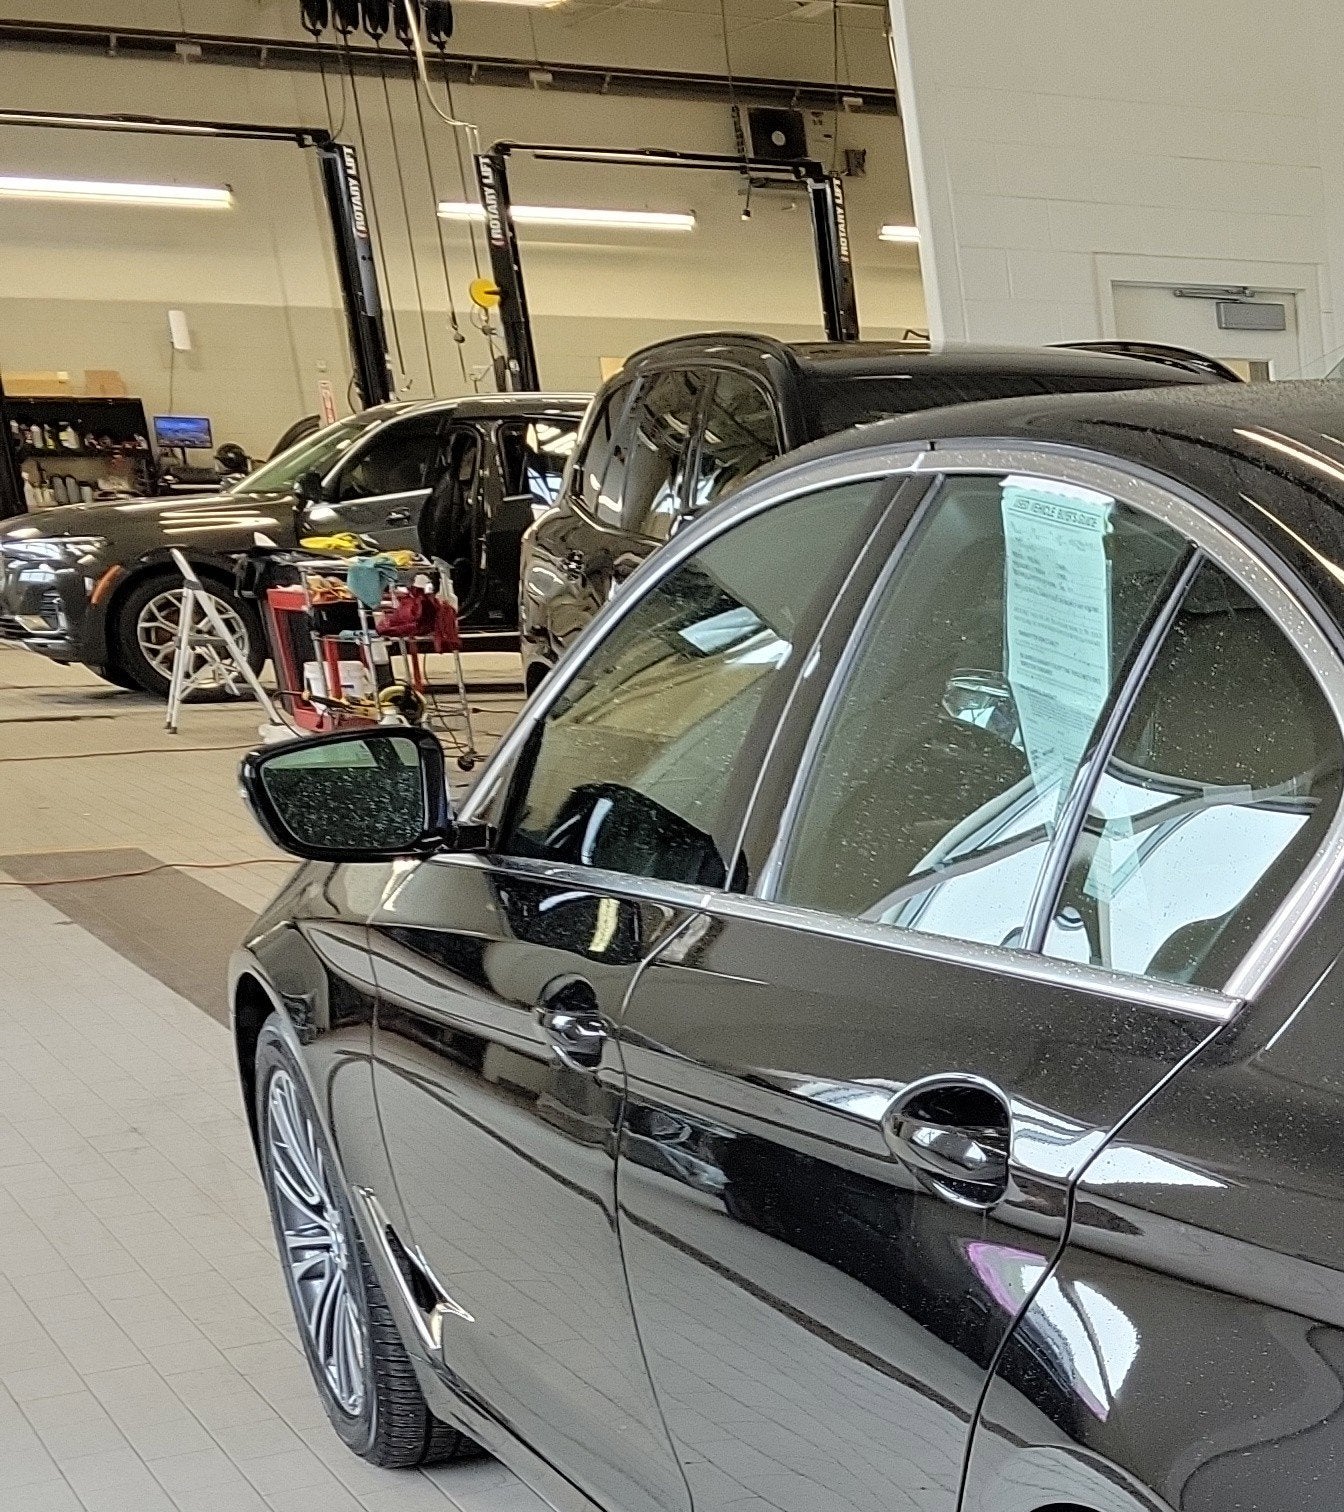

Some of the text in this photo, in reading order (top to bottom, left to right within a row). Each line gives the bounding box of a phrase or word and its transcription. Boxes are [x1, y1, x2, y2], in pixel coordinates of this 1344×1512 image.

[343, 146, 367, 231] ROTARY LIFT
[479, 156, 503, 239] ROTARY LIFT
